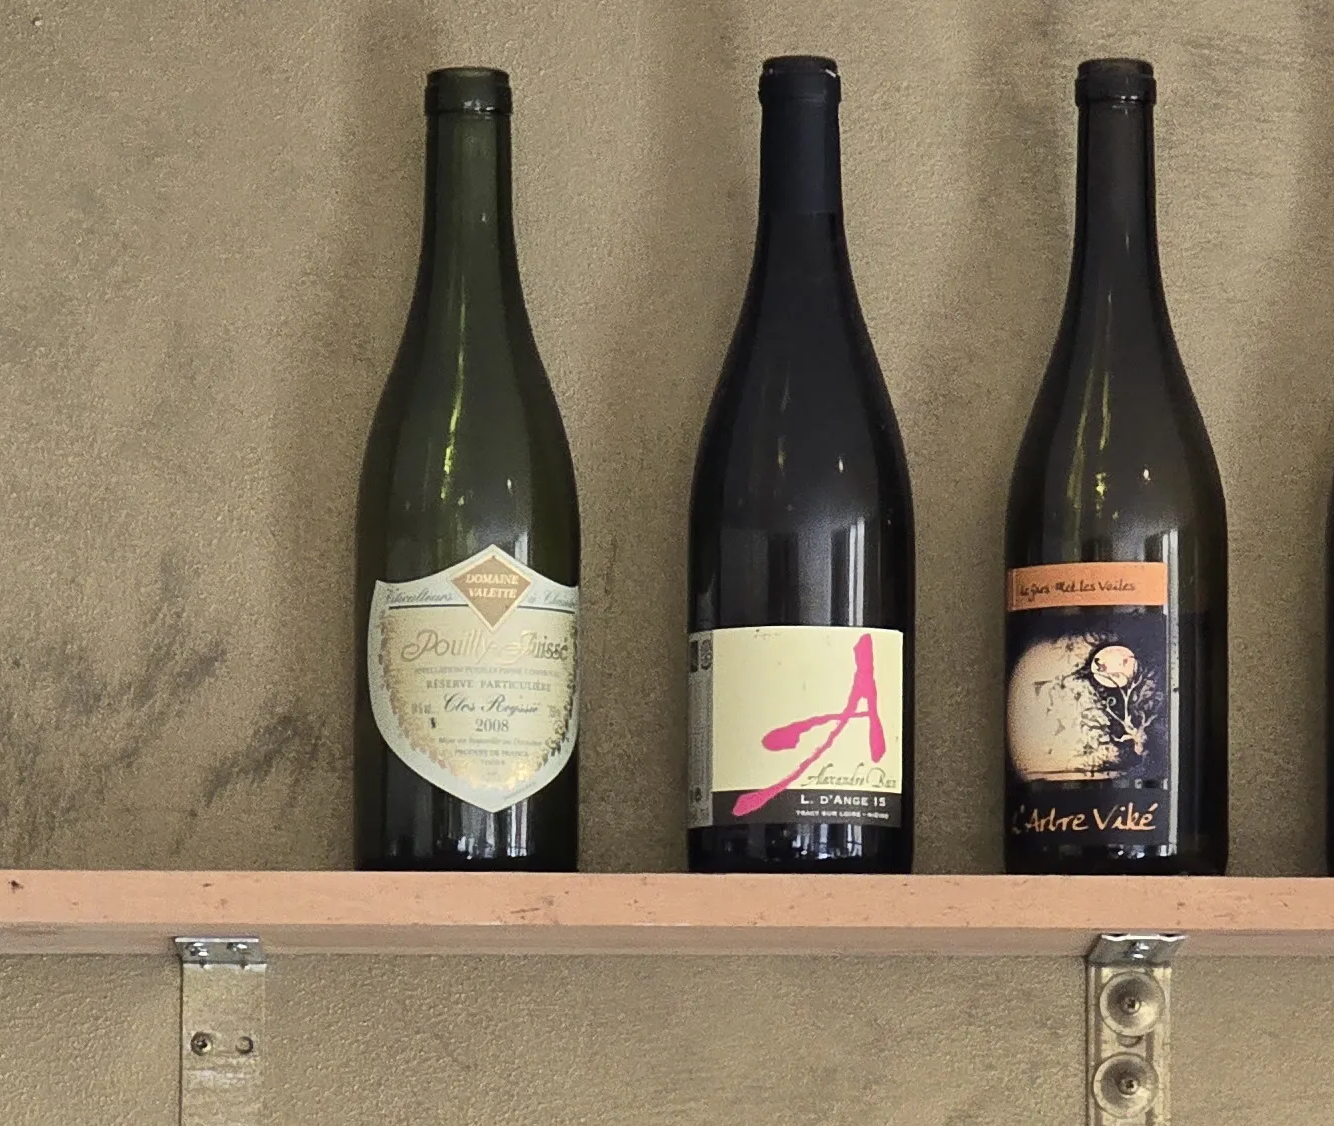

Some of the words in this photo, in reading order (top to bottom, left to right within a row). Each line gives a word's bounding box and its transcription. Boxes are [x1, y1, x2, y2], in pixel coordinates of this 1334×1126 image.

[466, 573, 519, 585] DOMAINE
[468, 587, 518, 599] VALETTE
[475, 718, 510, 733] 2008
[800, 794, 814, 804] L.
[820, 795, 869, 806] D'ANGE
[1092, 802, 1159, 832] Viké
